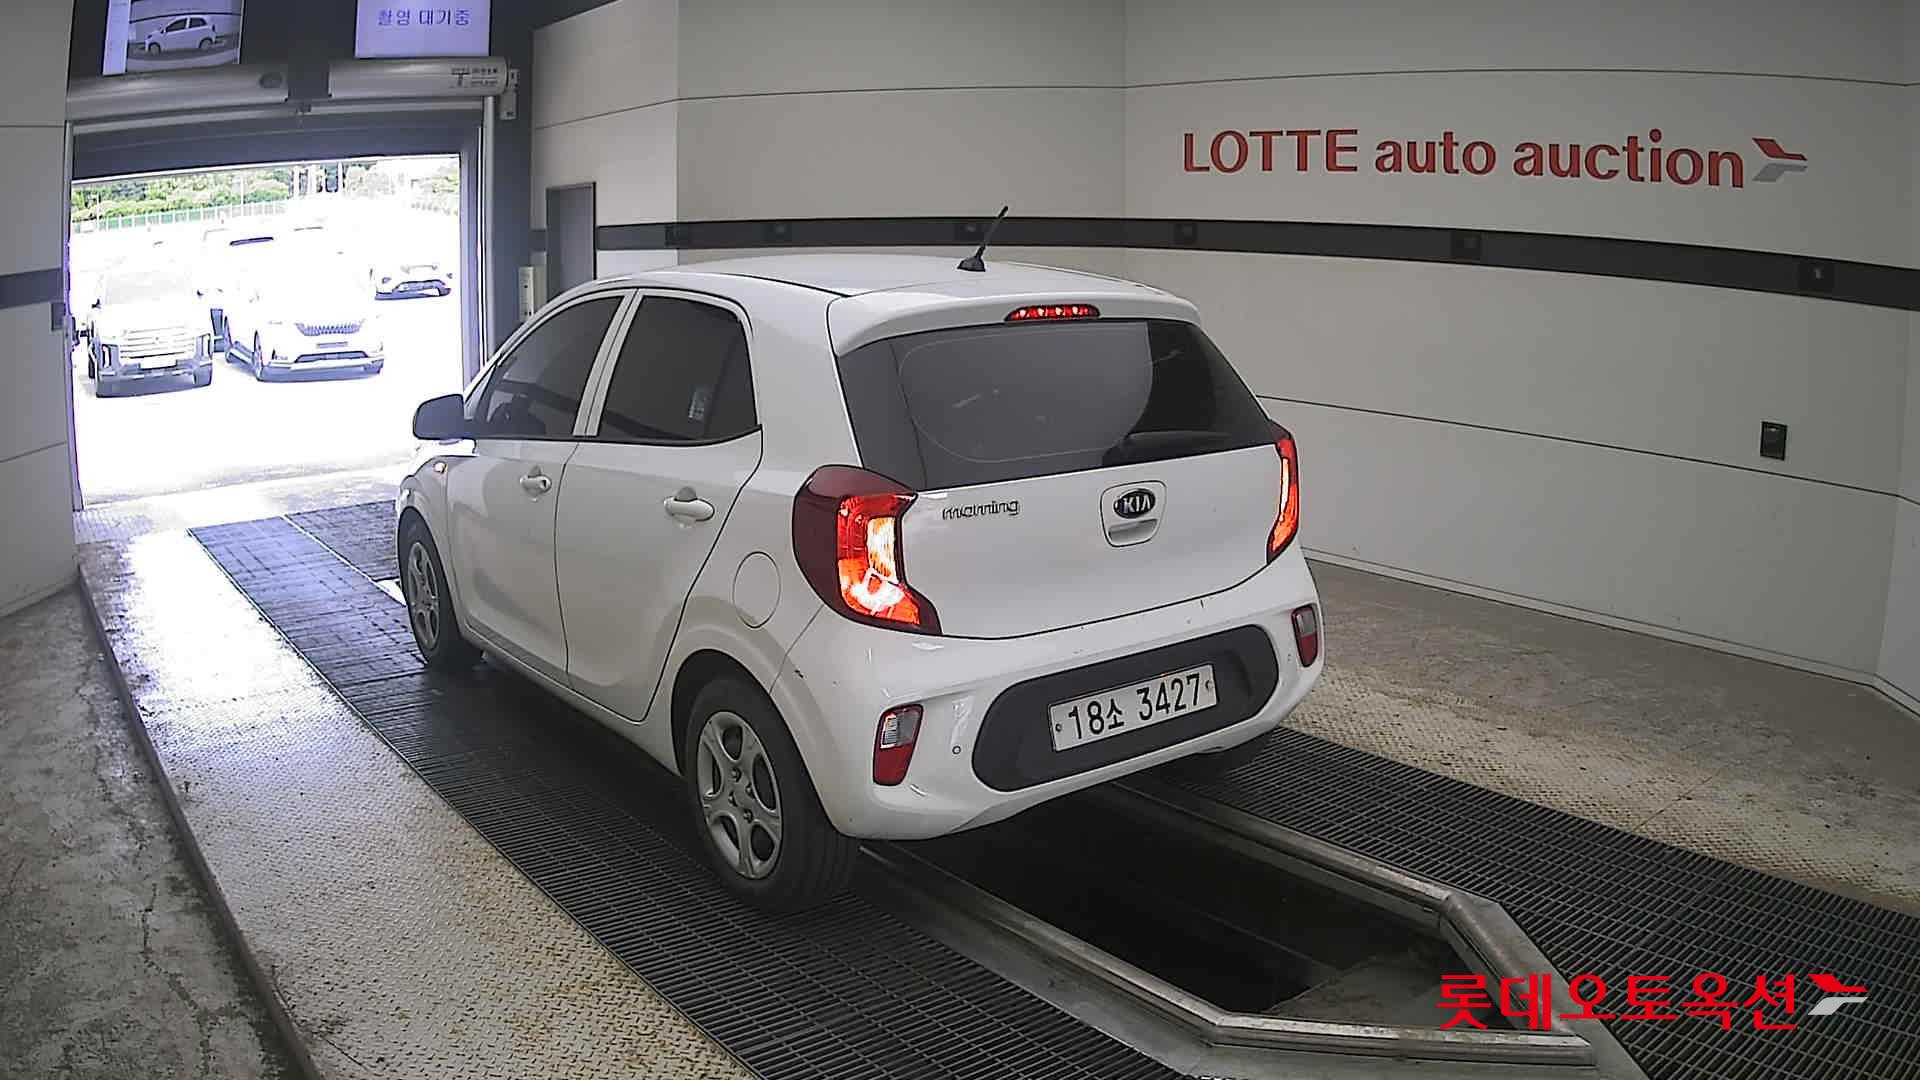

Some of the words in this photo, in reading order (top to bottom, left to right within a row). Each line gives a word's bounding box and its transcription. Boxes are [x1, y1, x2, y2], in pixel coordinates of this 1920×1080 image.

[1184, 129, 1358, 172] LOTTE
[1375, 131, 1496, 174] auto
[1513, 128, 1744, 188] auction
[1122, 494, 1150, 513] KIA
[1068, 698, 1125, 740] 18소
[1136, 673, 1200, 721] 3427
